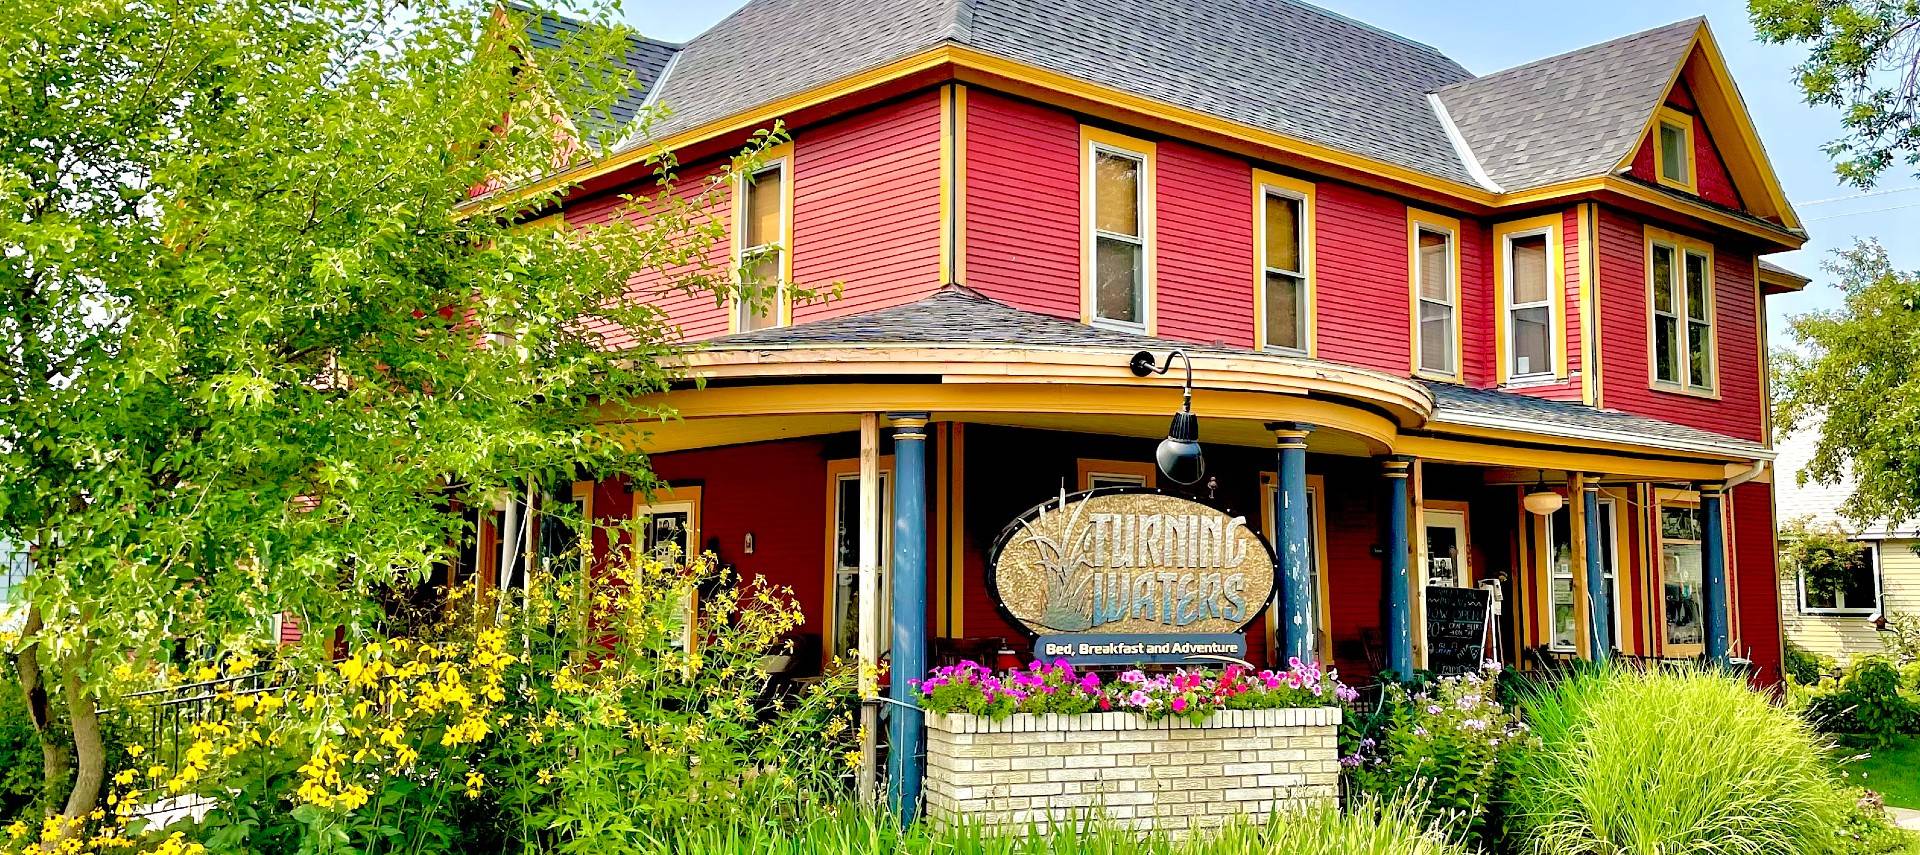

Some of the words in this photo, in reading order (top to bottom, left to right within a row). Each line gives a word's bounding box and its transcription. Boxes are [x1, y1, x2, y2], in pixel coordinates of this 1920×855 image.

[1089, 512, 1247, 569] TURNING
[1091, 571, 1244, 627] WATERS
[1046, 643, 1076, 657] Bed,
[1079, 641, 1145, 656] Breakfast
[1146, 642, 1171, 655] and
[1171, 641, 1238, 655] Adventure
